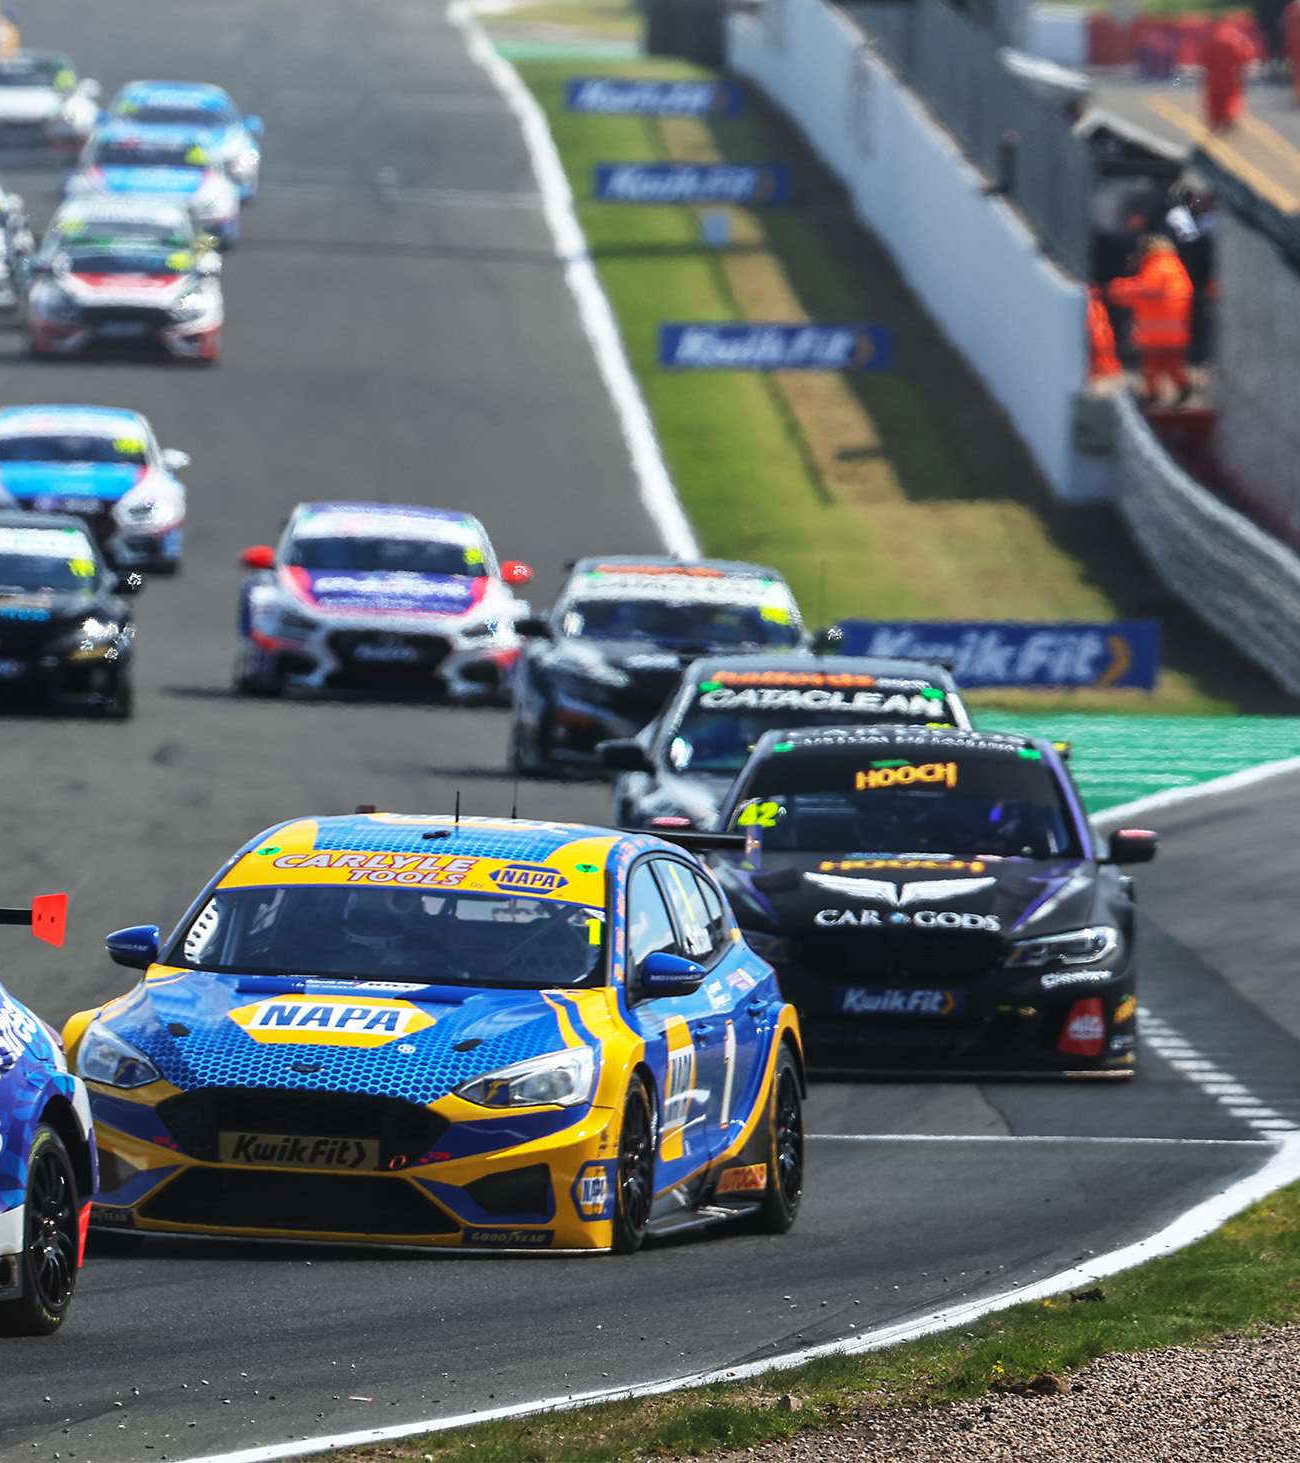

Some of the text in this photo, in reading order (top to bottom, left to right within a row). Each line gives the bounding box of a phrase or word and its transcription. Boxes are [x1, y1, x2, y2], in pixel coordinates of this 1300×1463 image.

[855, 761, 958, 791] HOOCH
[737, 801, 779, 828] 42
[272, 853, 476, 874] CARLYLE
[347, 868, 467, 886] TOOLS
[499, 868, 558, 889] NAPA
[586, 918, 601, 945] 1
[813, 908, 1001, 932] CAR GODS
[259, 1004, 401, 1032] NAPA
